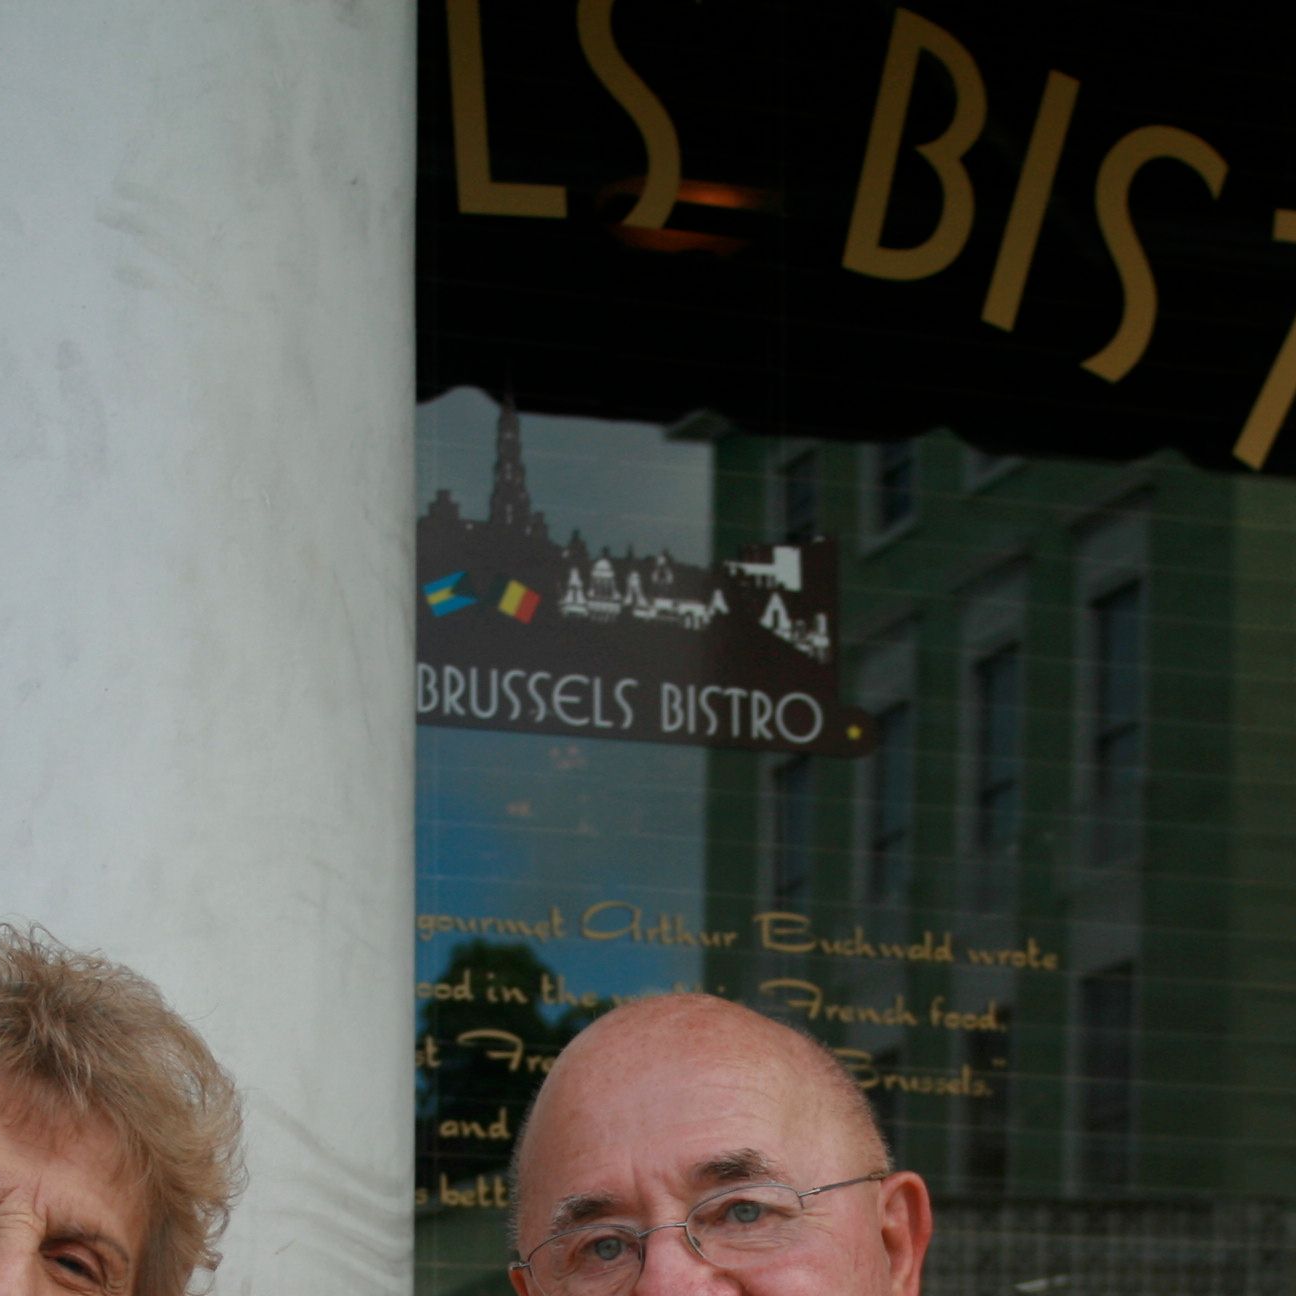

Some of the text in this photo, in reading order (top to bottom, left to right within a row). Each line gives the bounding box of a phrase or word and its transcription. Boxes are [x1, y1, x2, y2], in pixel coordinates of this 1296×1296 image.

[416, 661, 825, 745] BRUSSELS BISTRO
[415, 907, 568, 942] gourmet
[581, 900, 739, 947] Arthur
[967, 937, 1060, 971] wrote
[483, 973, 529, 1004] in
[539, 974, 599, 1009] the
[757, 977, 919, 1027] French
[438, 1105, 512, 1141] and
